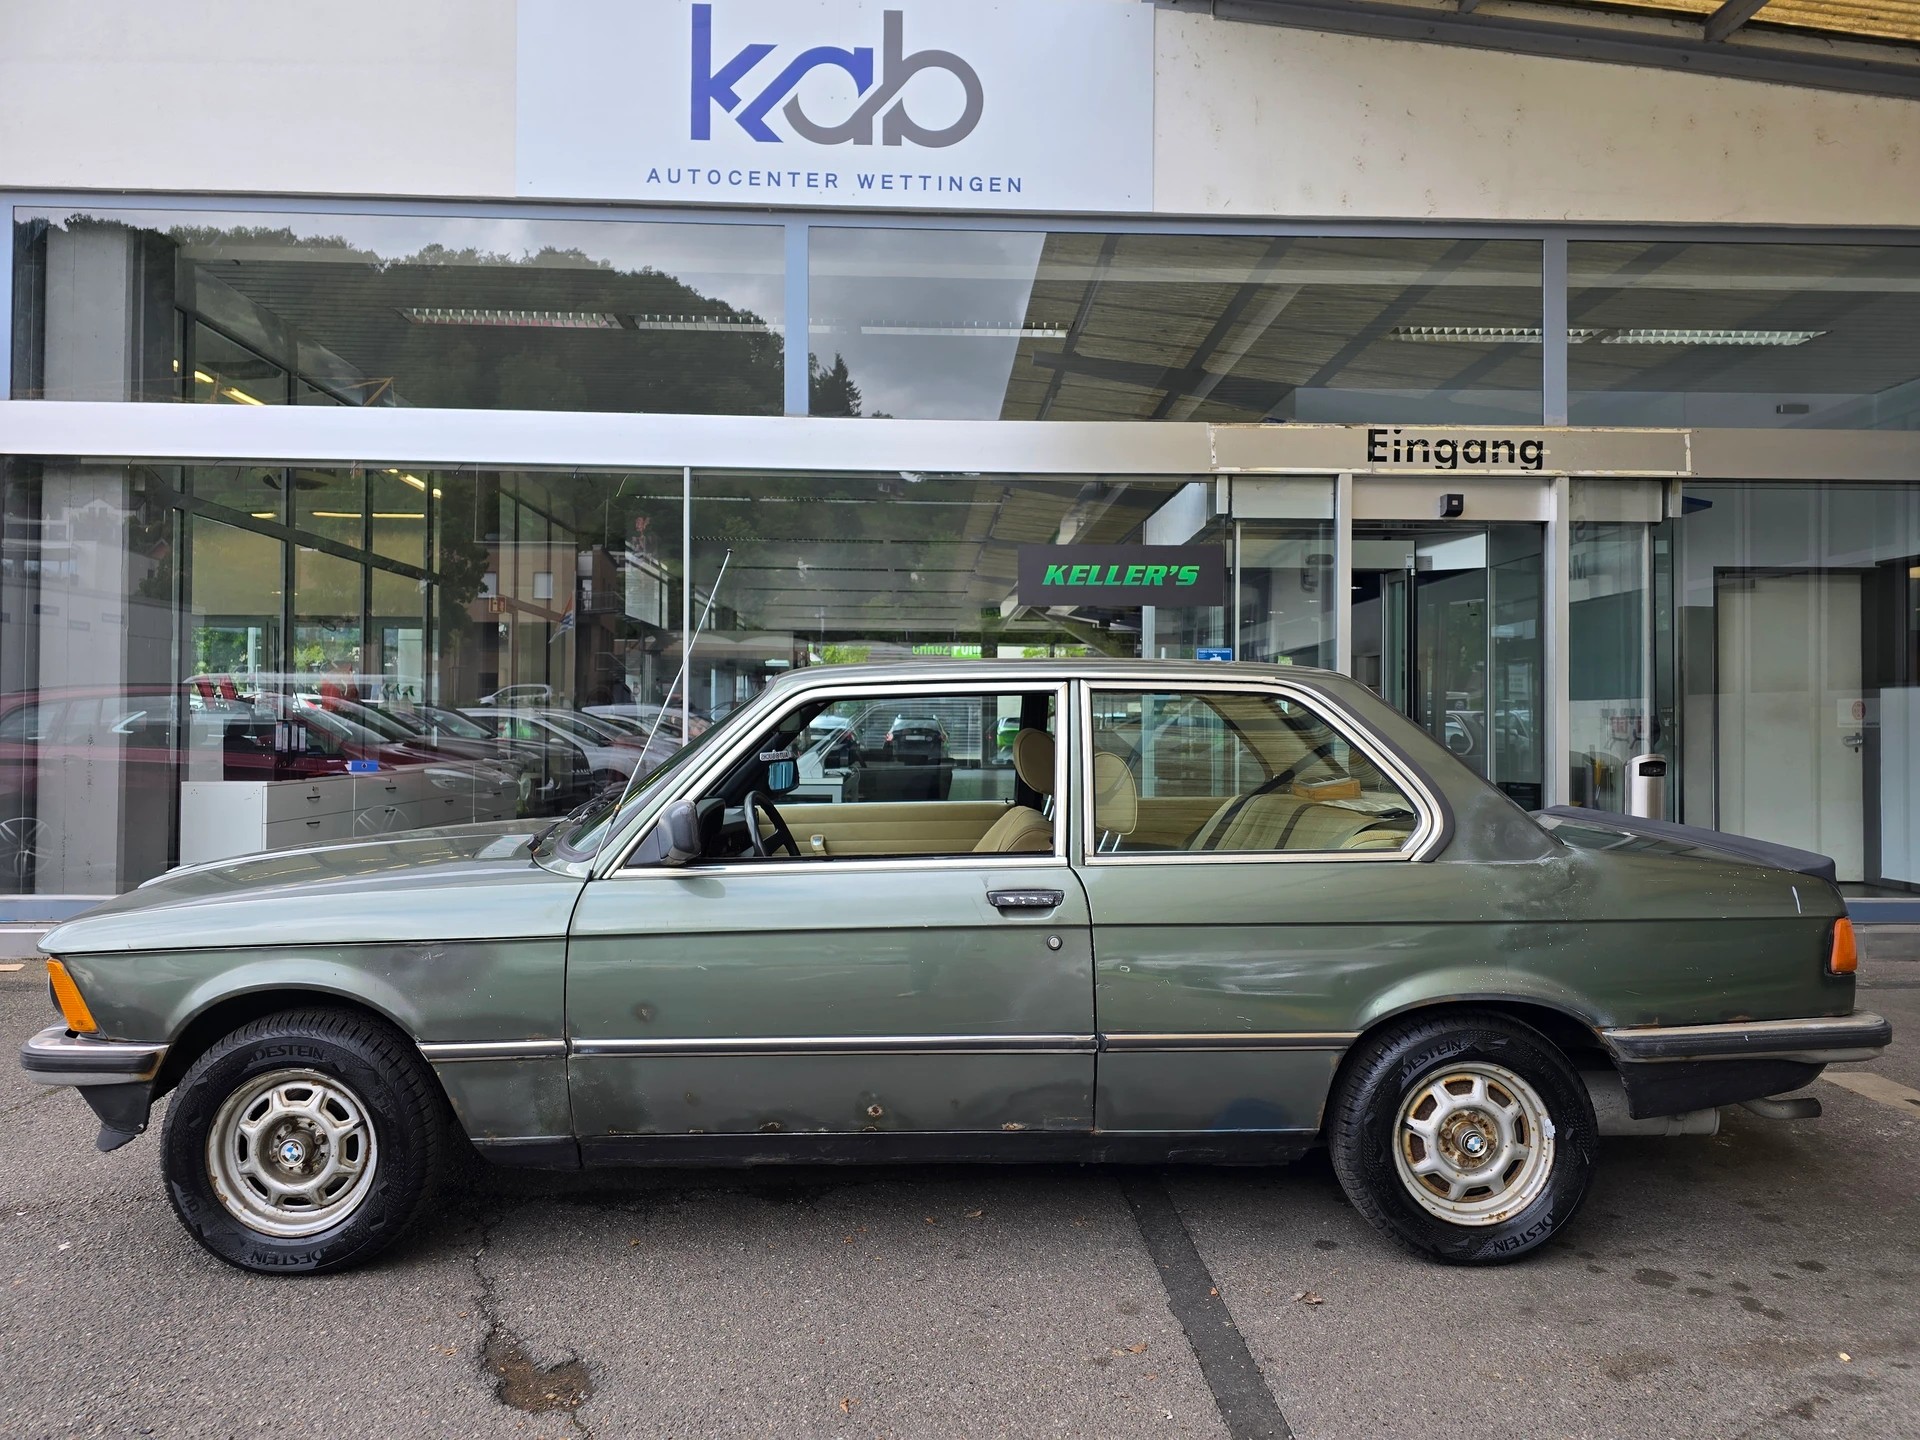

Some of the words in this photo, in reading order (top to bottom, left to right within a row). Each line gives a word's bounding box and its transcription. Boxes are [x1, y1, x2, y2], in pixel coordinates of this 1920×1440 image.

[690, 3, 984, 149] kab
[646, 167, 838, 189] AUTOCENTER
[856, 173, 1022, 193] WETTINGEN
[1367, 428, 1544, 470] Eingang
[1042, 564, 1200, 586] KELLER'S
